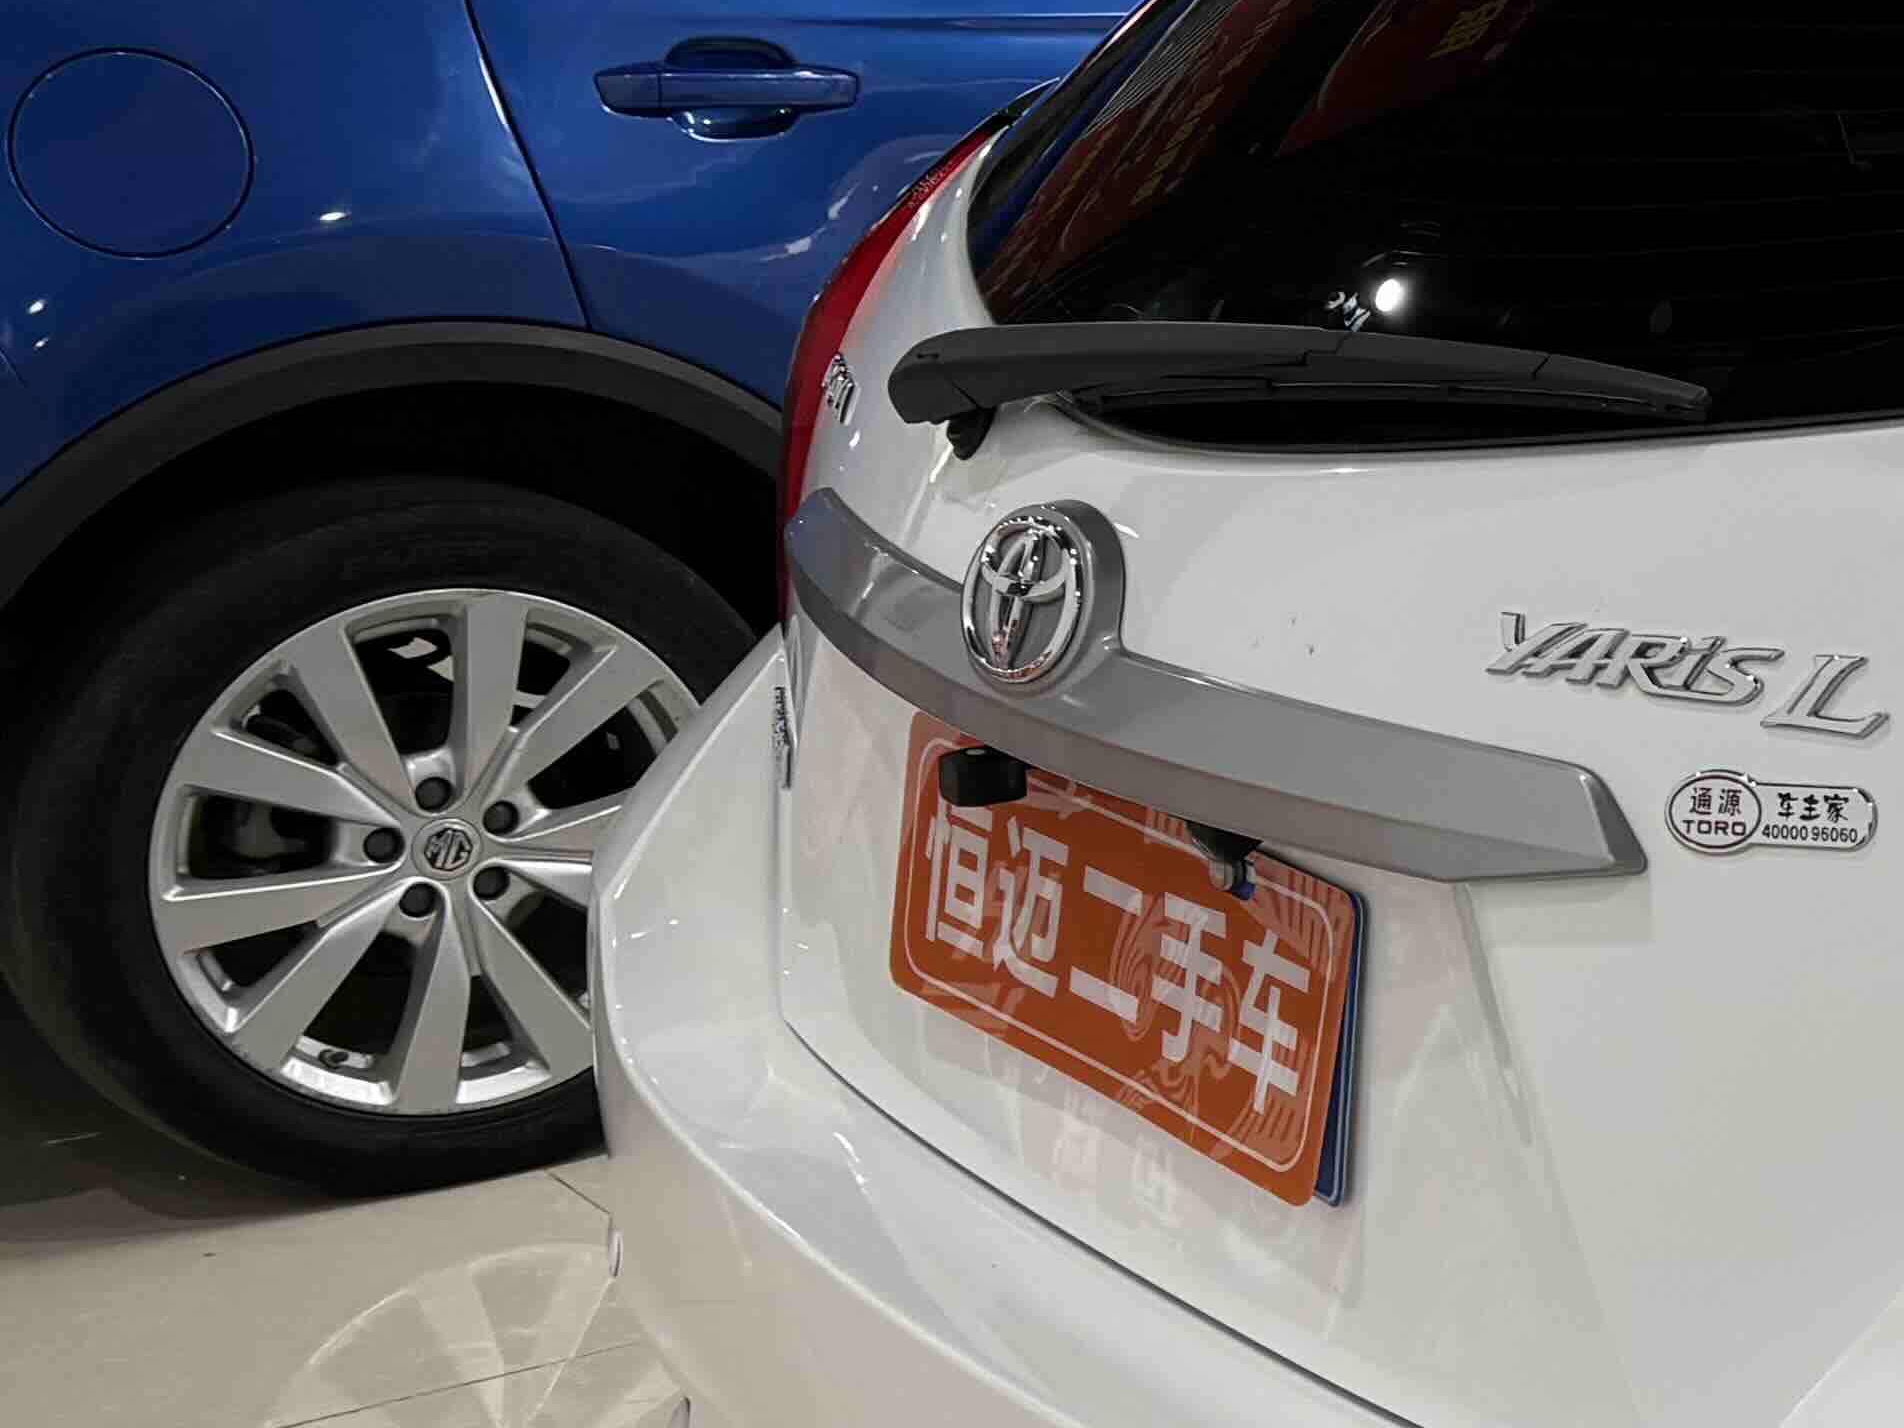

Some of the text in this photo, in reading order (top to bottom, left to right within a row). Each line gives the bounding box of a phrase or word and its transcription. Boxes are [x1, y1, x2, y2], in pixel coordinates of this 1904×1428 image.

[1485, 611, 1890, 740] YARIS L
[1689, 787, 1743, 817] 通源
[1777, 792, 1850, 823] 车主家
[1682, 819, 1747, 837] TORO
[426, 830, 471, 869] MG
[925, 798, 1310, 1115] 恒迈二手车
